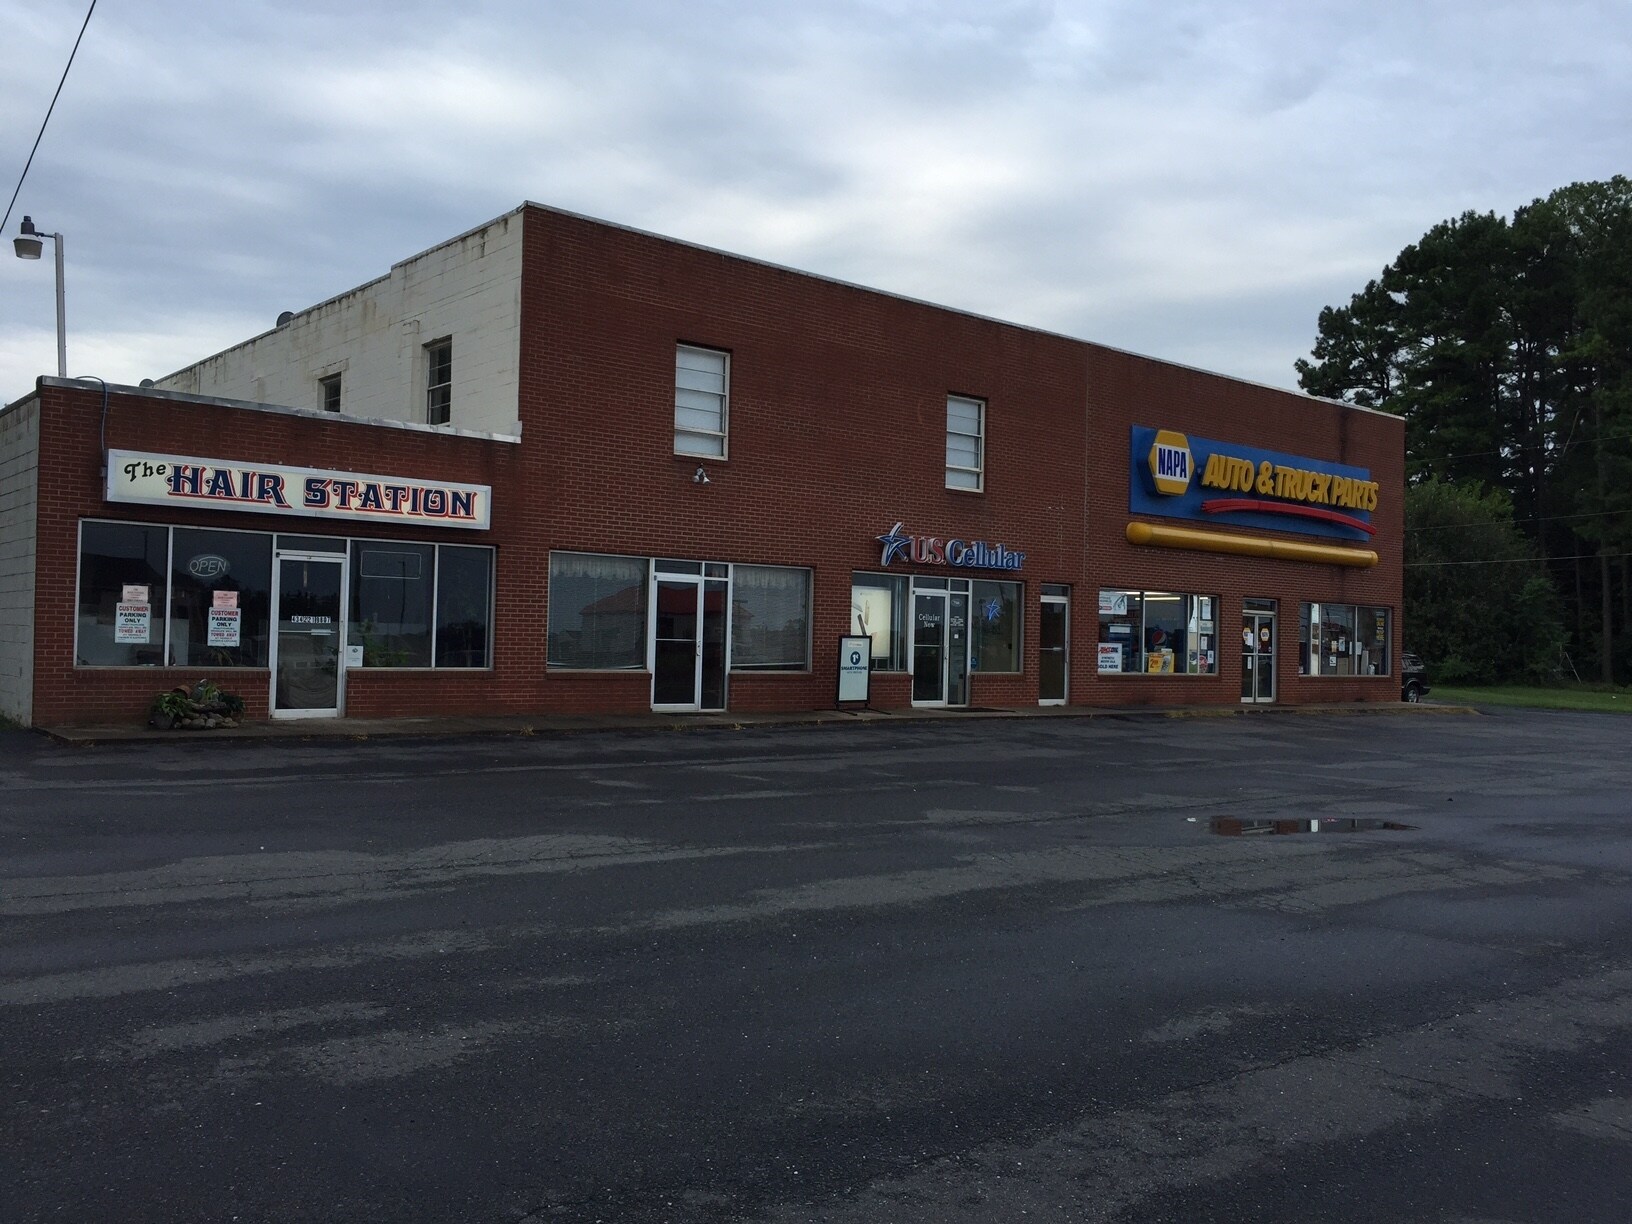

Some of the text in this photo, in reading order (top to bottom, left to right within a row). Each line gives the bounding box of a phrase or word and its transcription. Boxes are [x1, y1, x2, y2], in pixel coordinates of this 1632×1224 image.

[124, 461, 478, 520] The HAIR STATION
[1158, 448, 1379, 511] NAPA AUTO & TRUCK PARTS
[189, 559, 227, 572] OPEN
[909, 535, 1026, 570] U.S. Cellular
